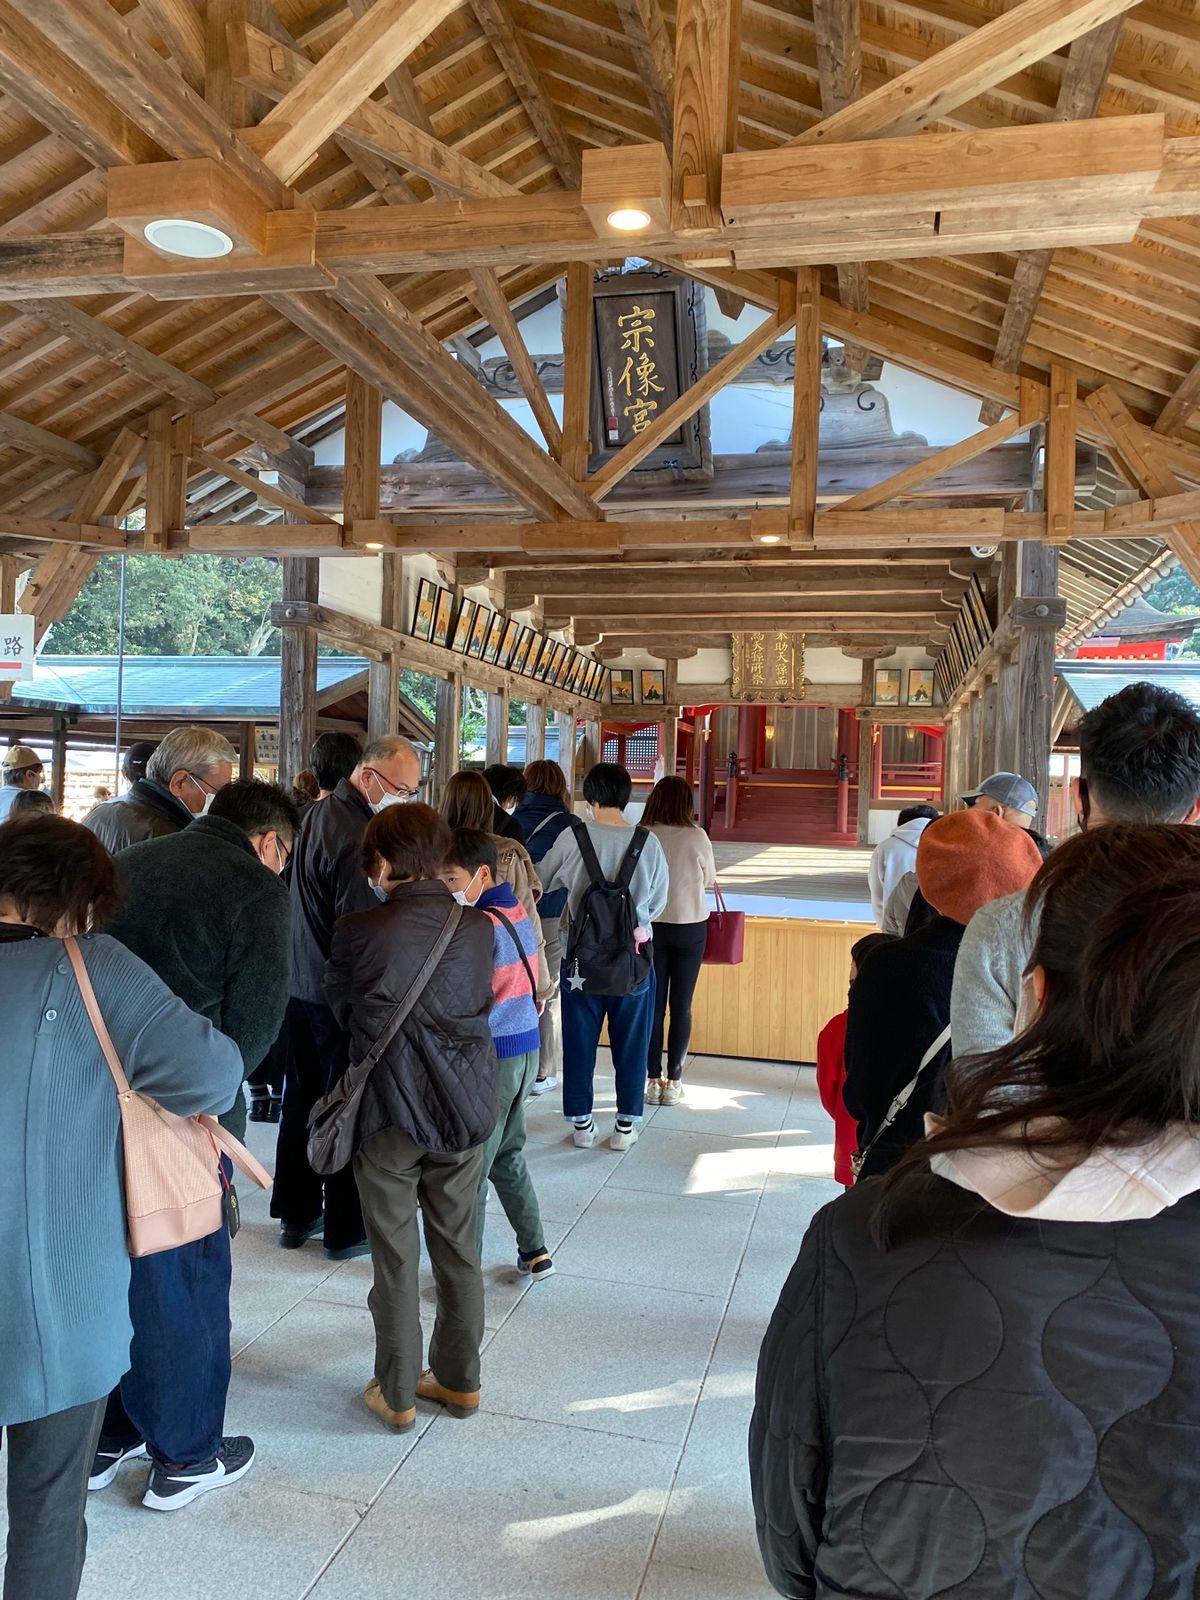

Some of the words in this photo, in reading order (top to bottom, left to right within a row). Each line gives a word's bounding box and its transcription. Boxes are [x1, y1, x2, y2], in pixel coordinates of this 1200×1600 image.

[618, 305, 665, 435] 宗像宮
[4, 635, 24, 657] 路
